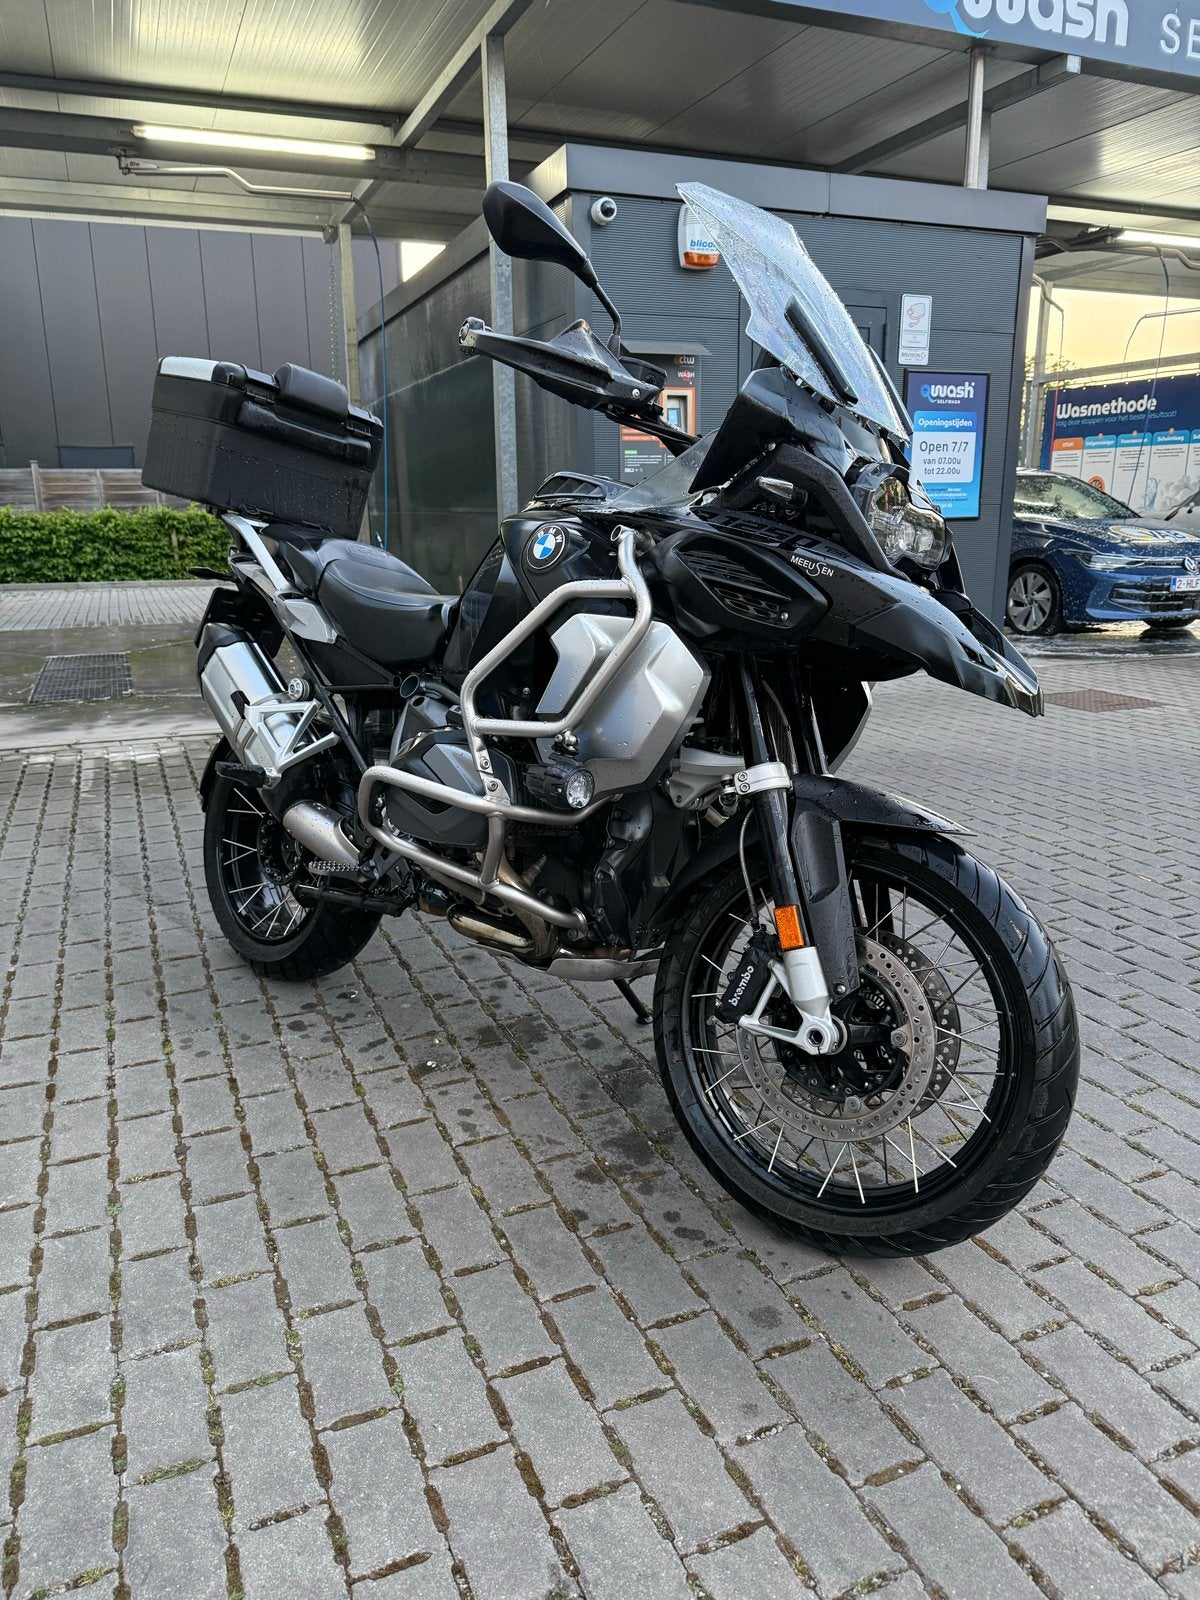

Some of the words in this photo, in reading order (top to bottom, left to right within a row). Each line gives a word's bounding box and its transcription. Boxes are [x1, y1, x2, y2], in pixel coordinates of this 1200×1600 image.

[690, 239, 716, 248] blico
[677, 371, 696, 379] WASH
[1056, 394, 1157, 420] Wasmethode
[918, 417, 973, 428] Openingstijden
[919, 440, 949, 454] Open
[951, 440, 969, 453] 7/7
[923, 457, 936, 465] van
[937, 457, 962, 465] 07.00u
[924, 467, 935, 475] tot
[936, 467, 961, 475] 22.00u
[537, 527, 563, 543] BMW
[790, 555, 834, 577] MEEUSEN
[728, 965, 755, 1007] brembo
